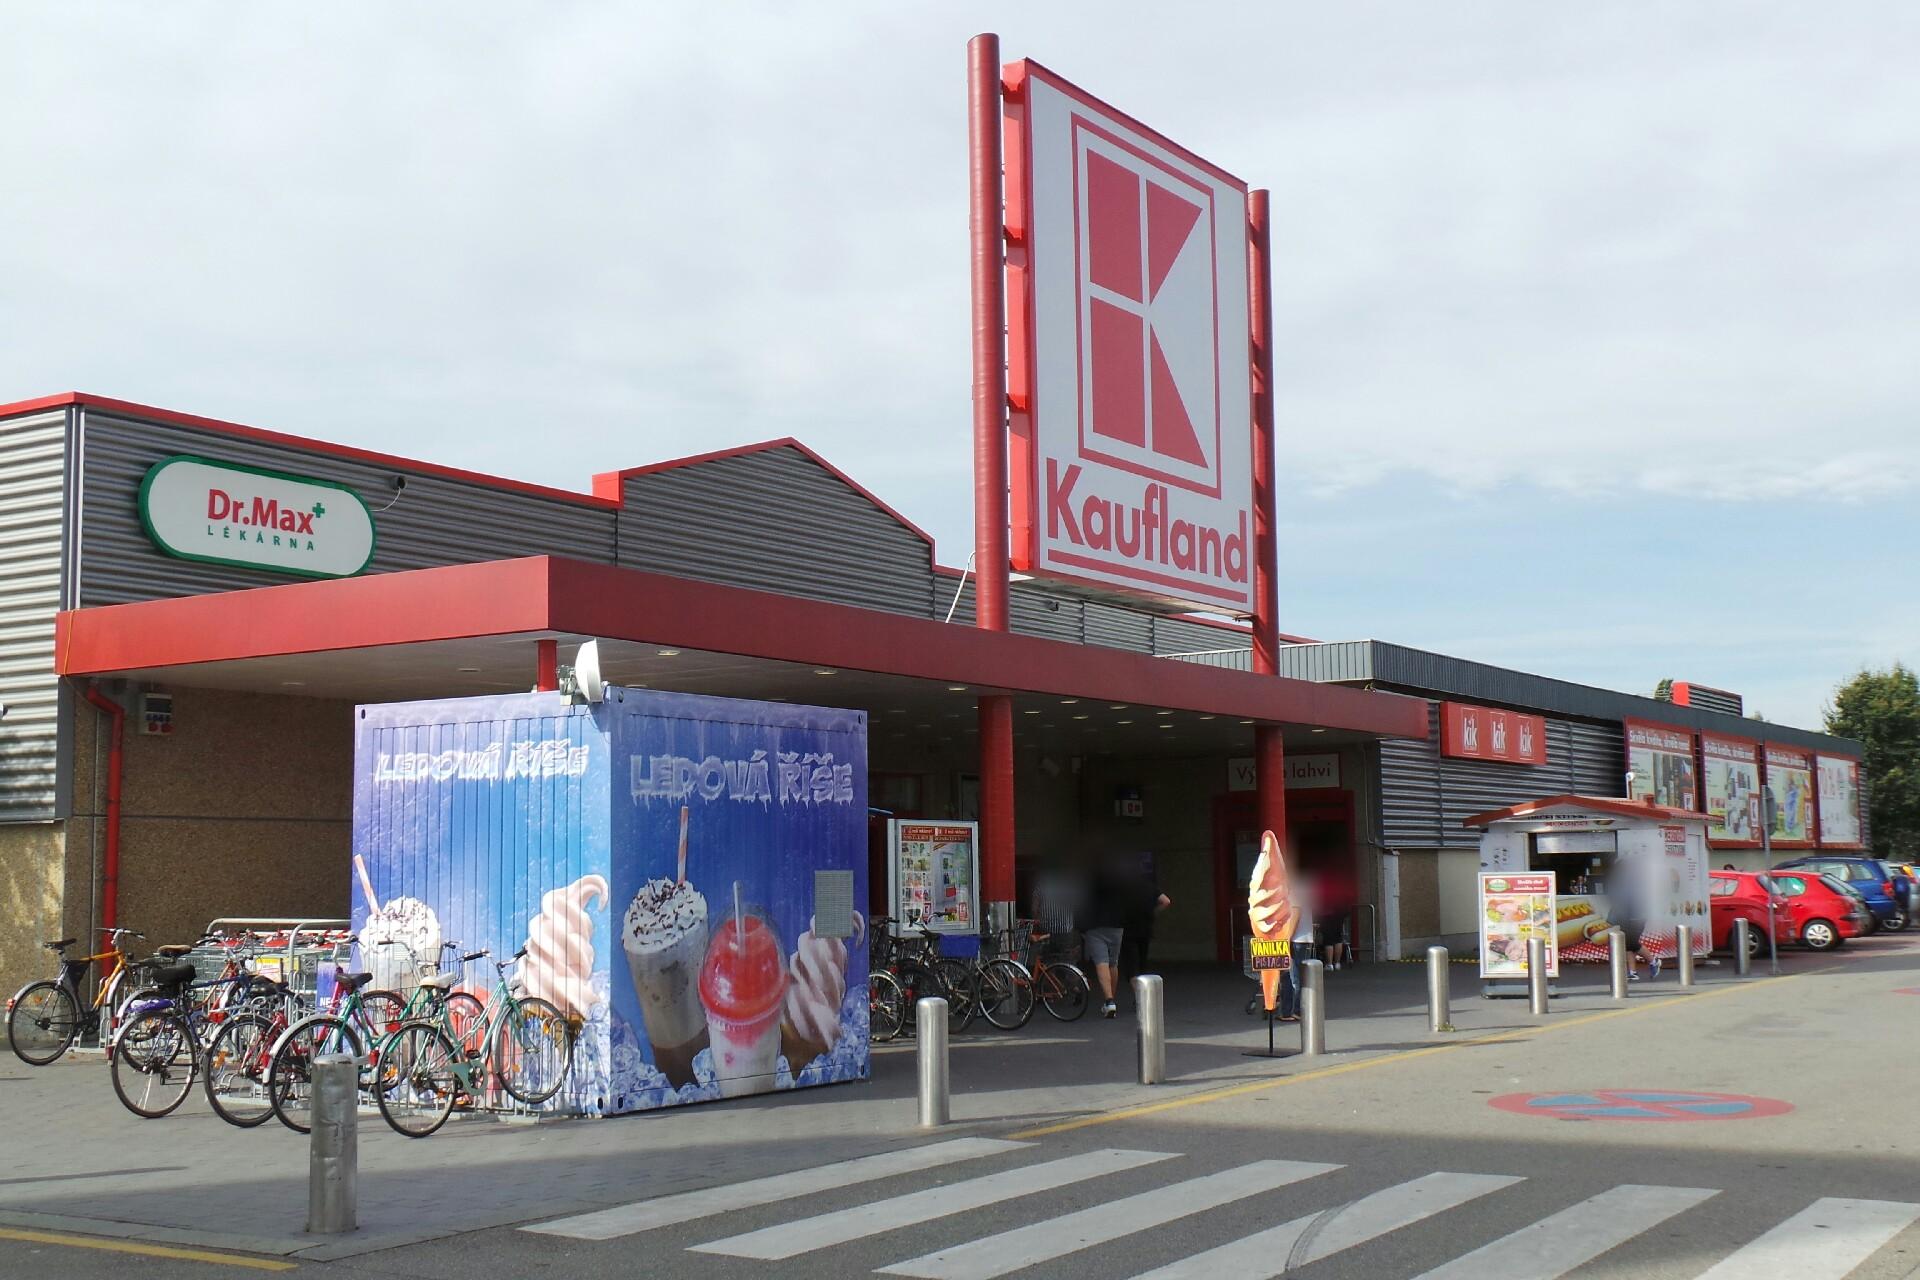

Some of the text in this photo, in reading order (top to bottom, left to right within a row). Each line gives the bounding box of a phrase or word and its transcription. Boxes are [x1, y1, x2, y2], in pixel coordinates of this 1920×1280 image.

[207, 524, 315, 551] LÉKÁRNA
[1047, 457, 1248, 583] Kaufland
[373, 739, 590, 790] LEDOVÁ ŘÍŠE
[630, 750, 855, 811] LEDOVÁ ŘÍŠE
[1252, 941, 1289, 956] VANILKA
